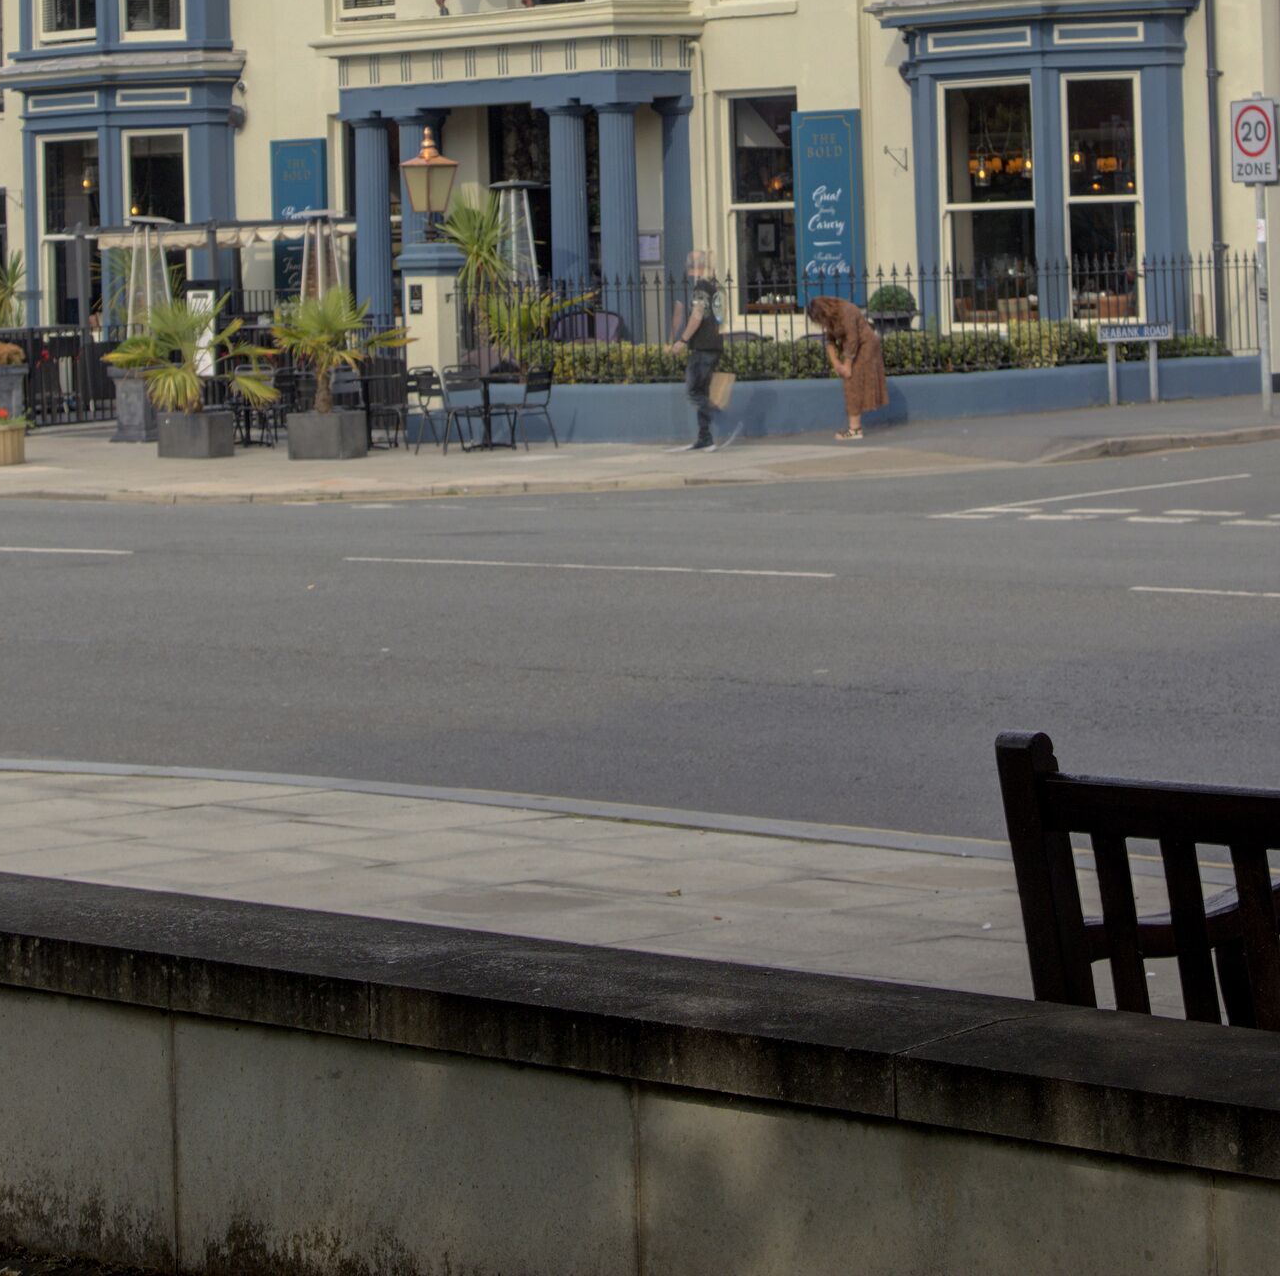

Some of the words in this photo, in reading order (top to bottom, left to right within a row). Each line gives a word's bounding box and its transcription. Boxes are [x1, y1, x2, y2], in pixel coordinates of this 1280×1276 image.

[1240, 120, 1267, 143] 20
[807, 145, 843, 158] BOLD
[1237, 162, 1272, 176] ZONE
[812, 185, 841, 207] Great
[808, 214, 844, 235] Carvery
[1101, 326, 1140, 339] SEABANK
[1144, 324, 1168, 337] ROAD
